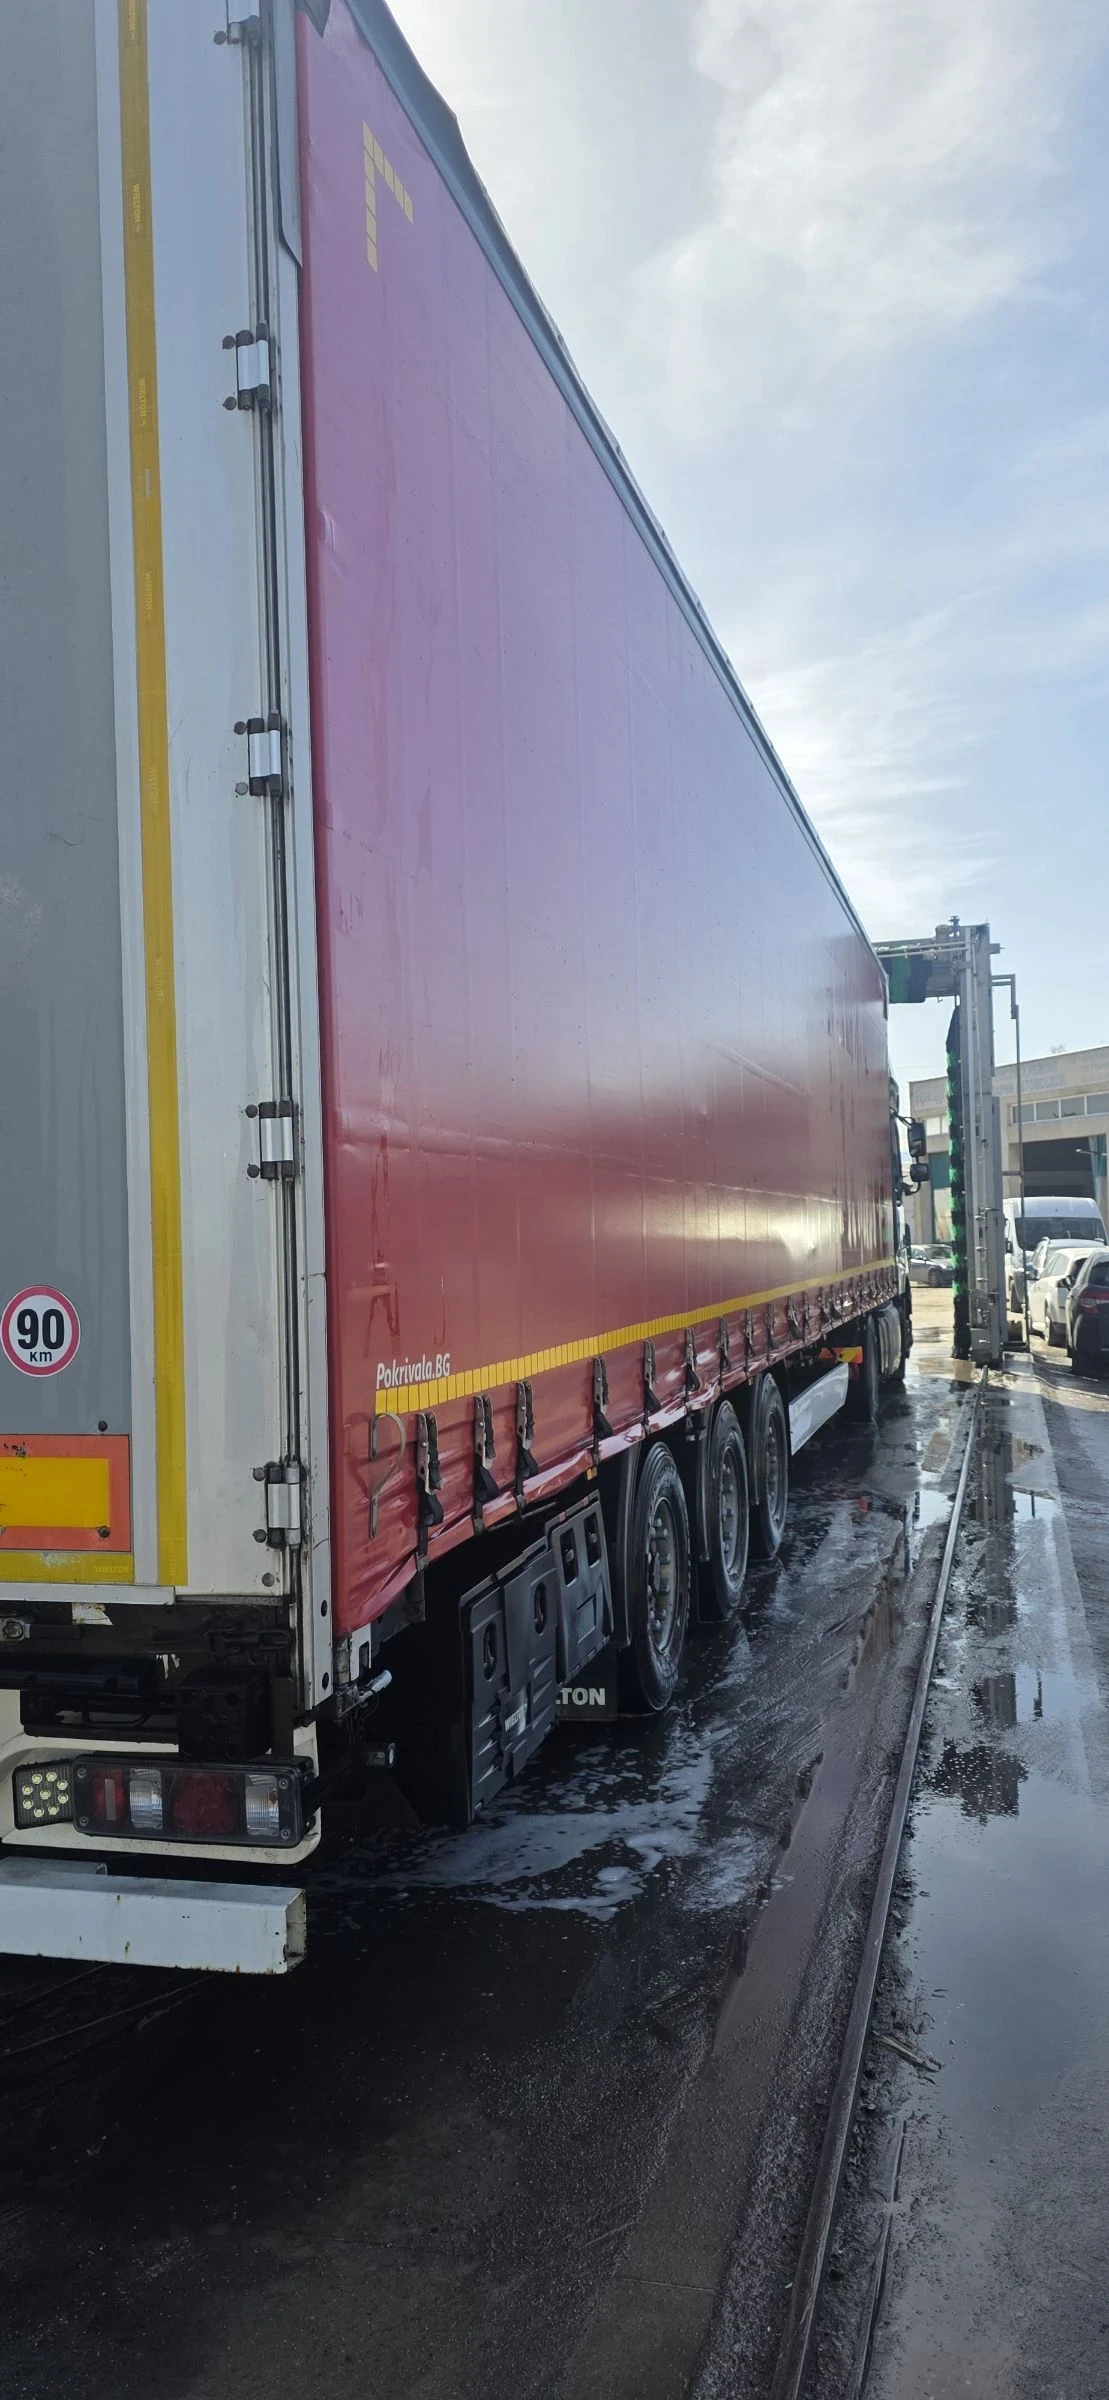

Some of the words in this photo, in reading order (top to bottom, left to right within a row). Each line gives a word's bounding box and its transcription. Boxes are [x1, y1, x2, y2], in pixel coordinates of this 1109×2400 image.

[132, 184, 141, 223] WIELTON
[137, 377, 147, 417] WIELTON
[144, 570, 153, 610] WIELTON
[17, 1308, 65, 1350] 90
[376, 1352, 450, 1390] Pokrivala.BG
